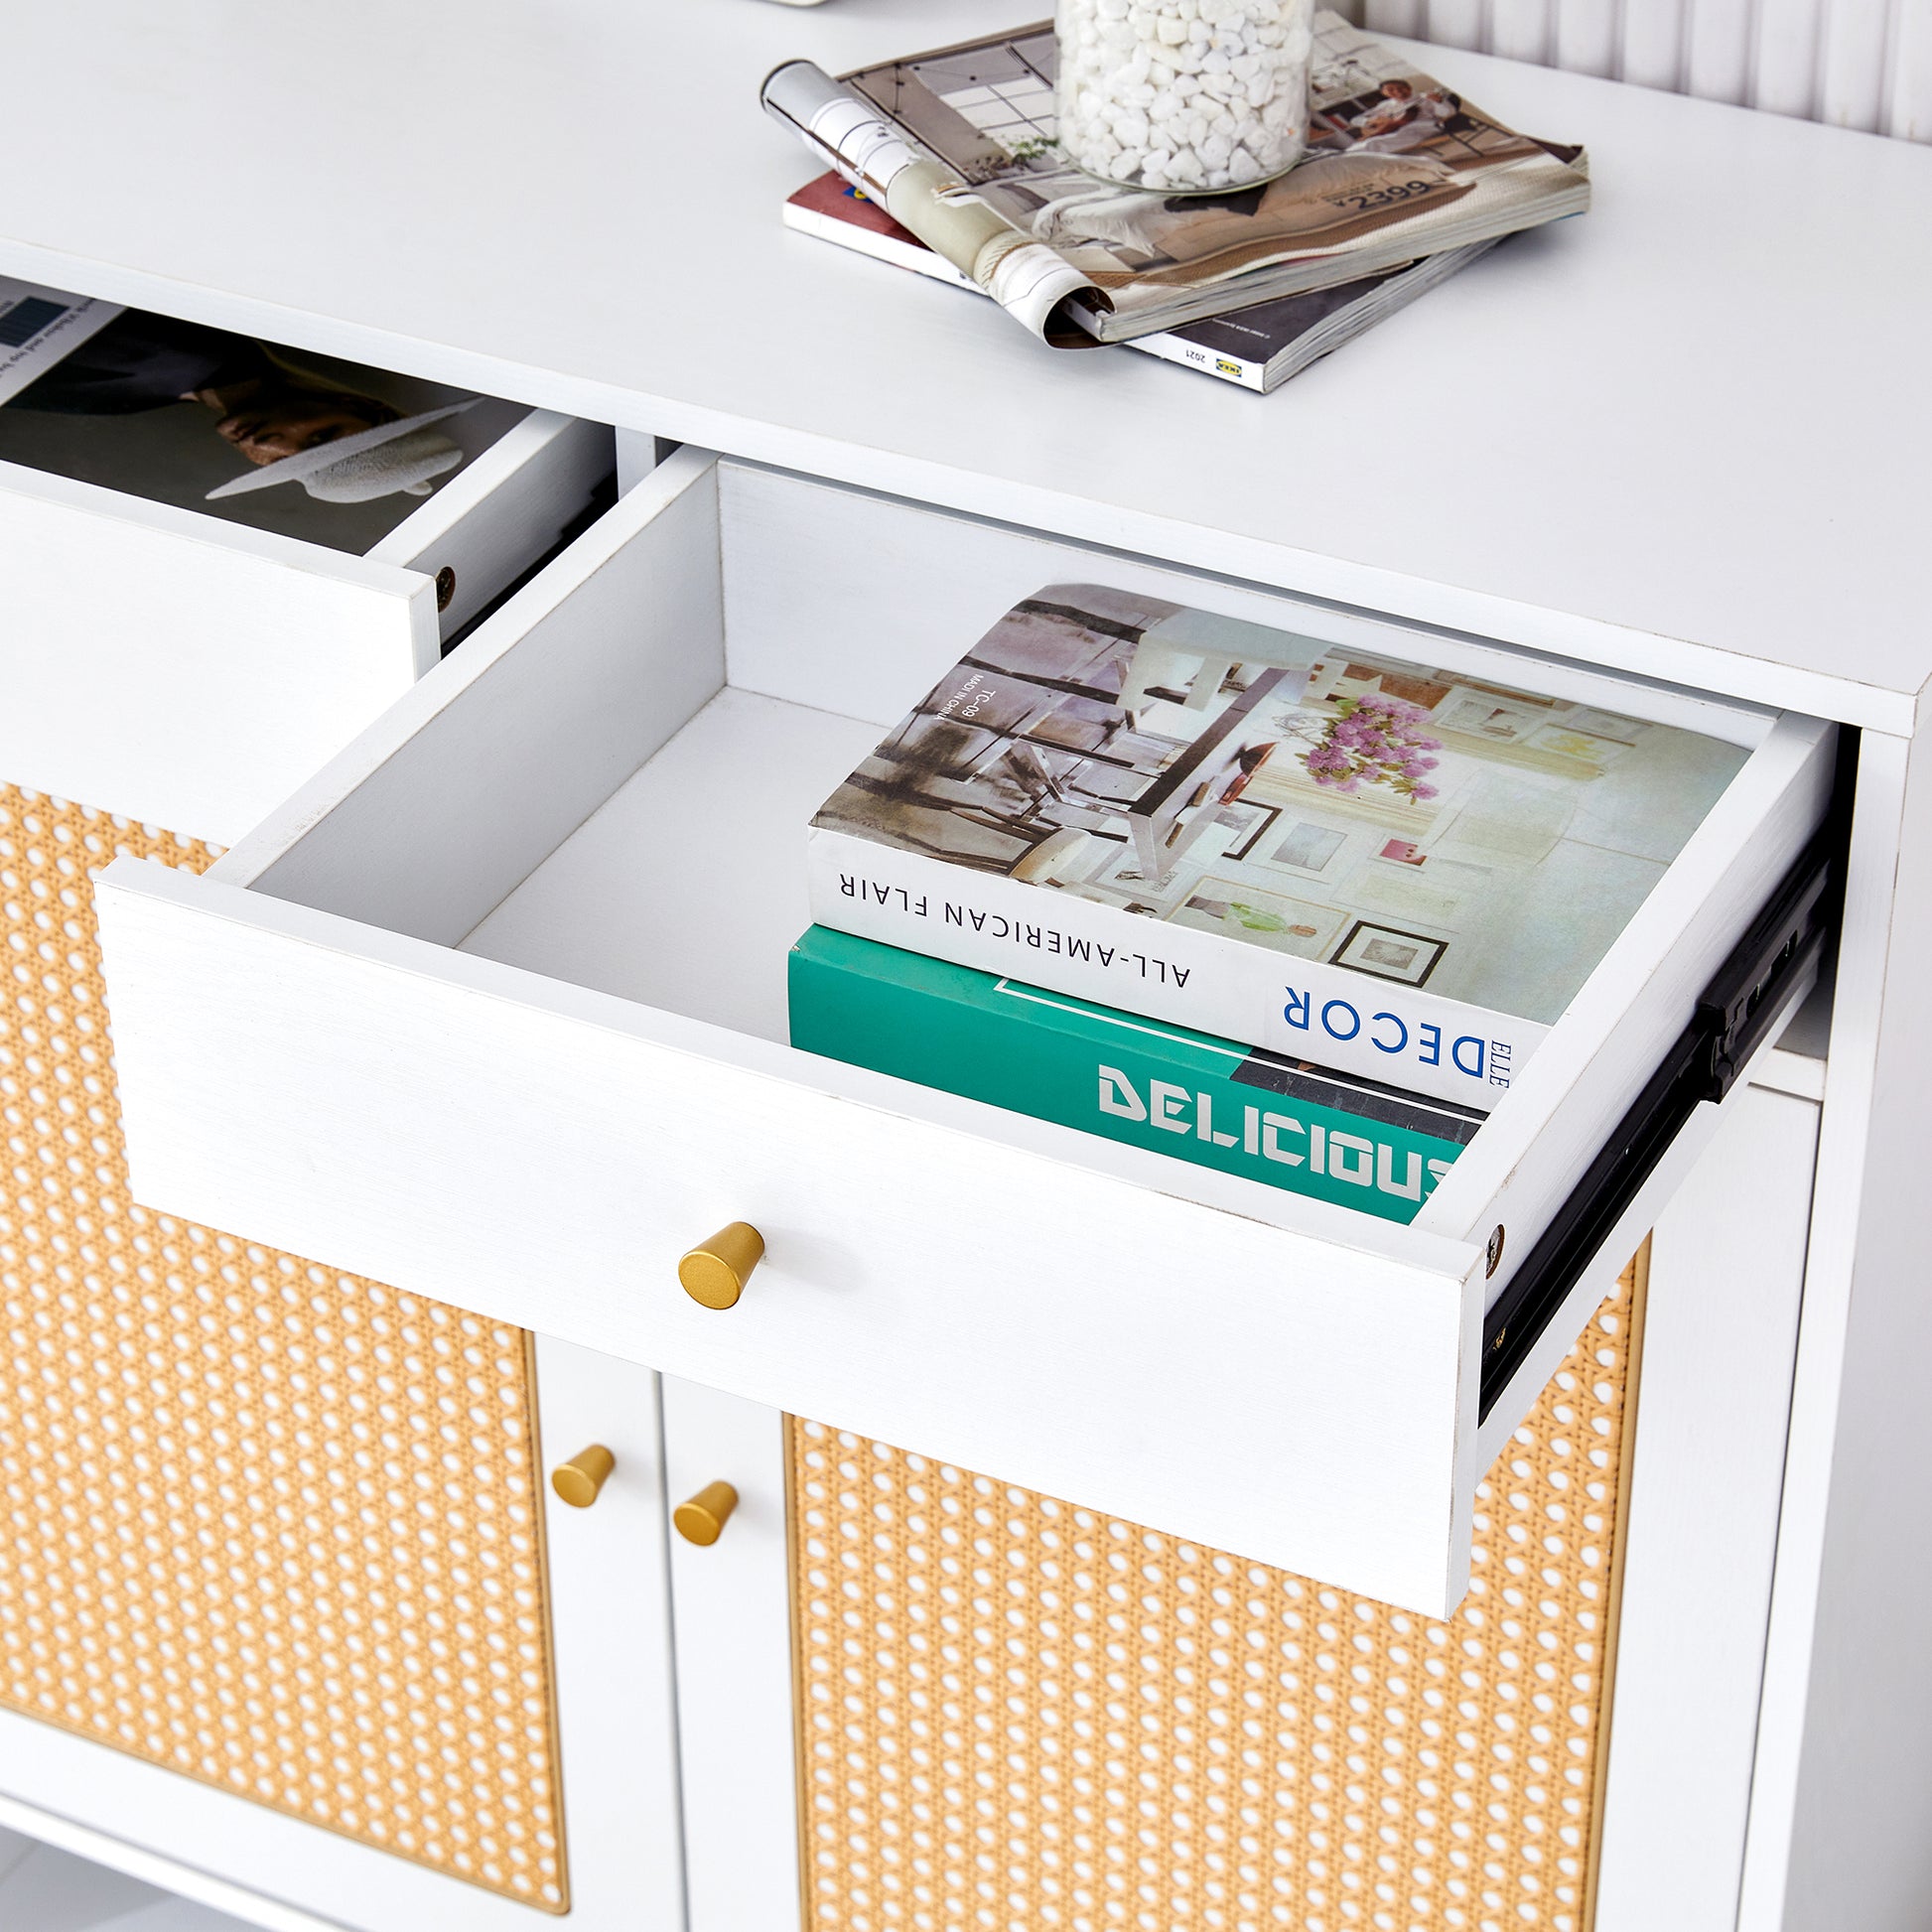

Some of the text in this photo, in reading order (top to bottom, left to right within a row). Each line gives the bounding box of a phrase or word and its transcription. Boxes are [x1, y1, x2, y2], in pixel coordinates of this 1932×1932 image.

[1185, 349, 1241, 375] IKEA 2021
[933, 699, 960, 721] CHINA
[961, 689, 997, 718] TC-09
[839, 873, 1191, 988] ALL-AMERICAN FLAIR
[1284, 986, 1485, 1079] DECOR
[1489, 1039, 1512, 1089] ELLE
